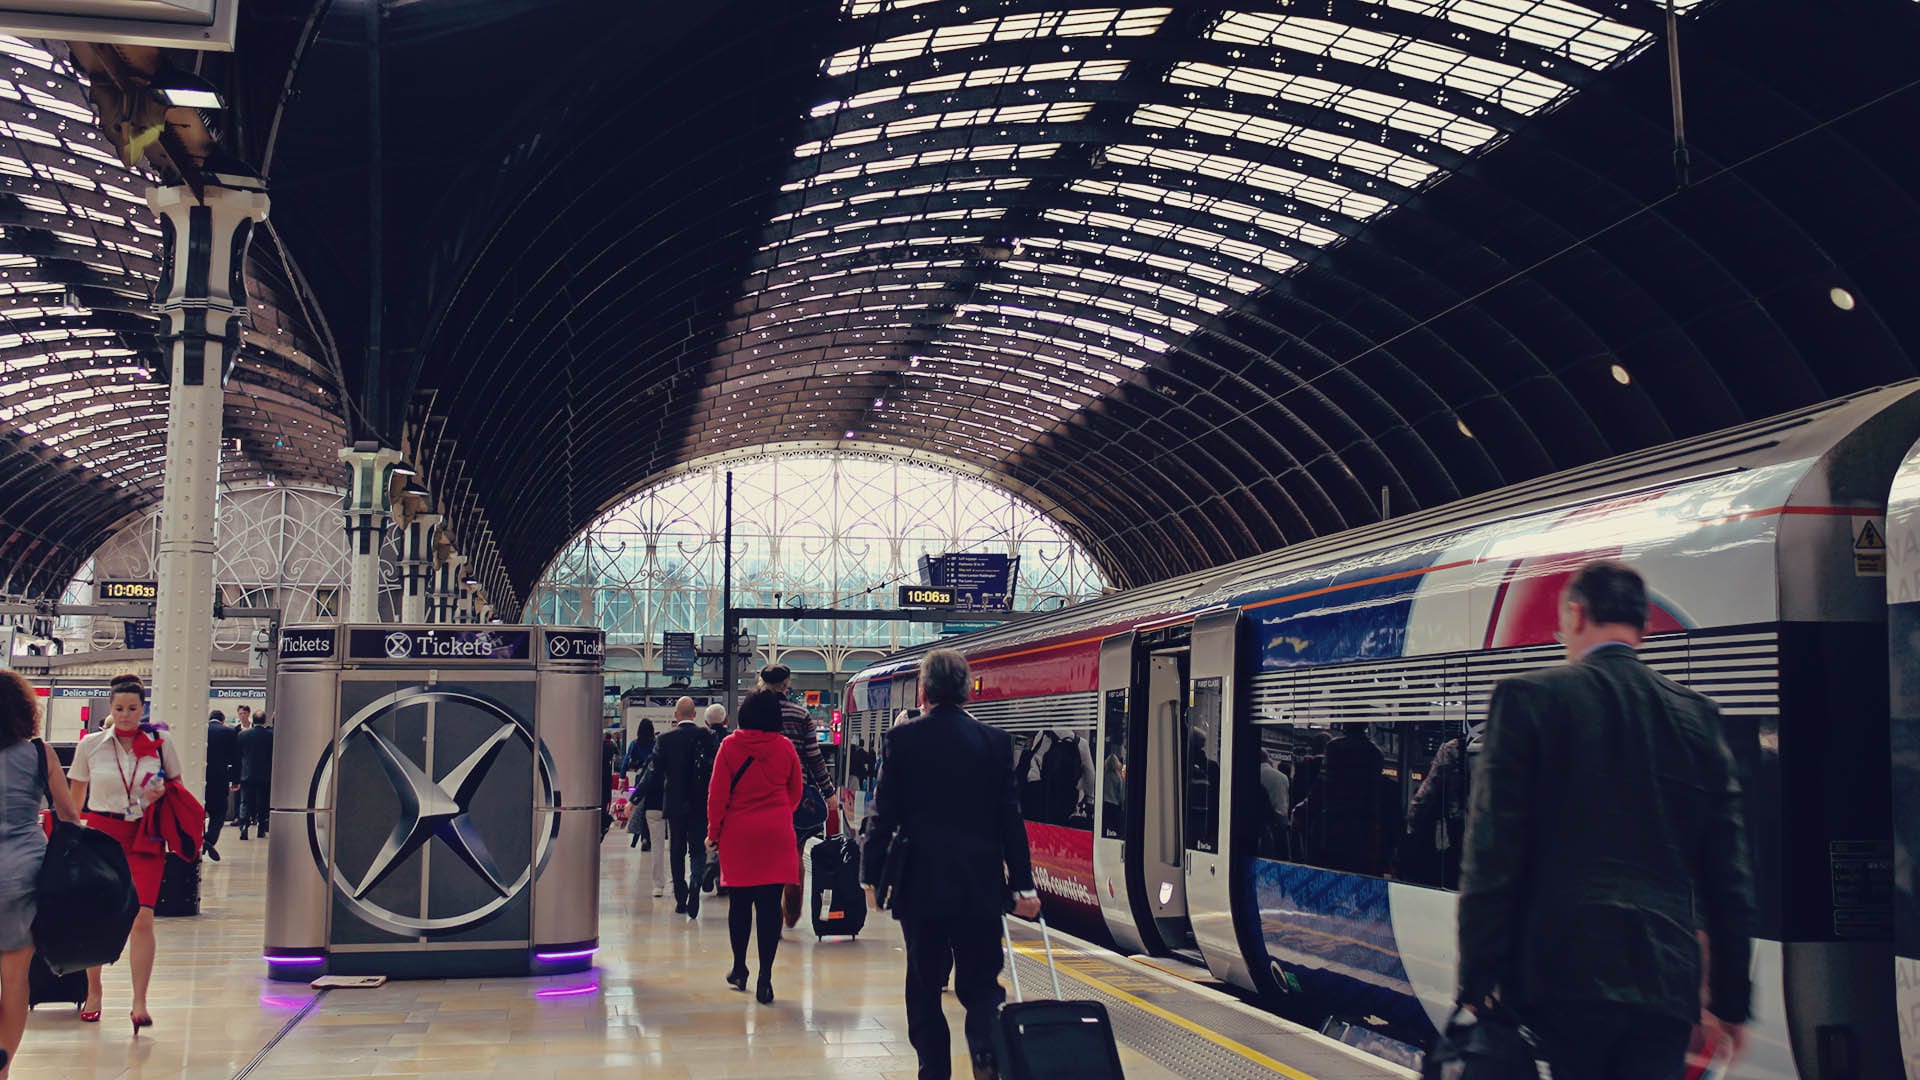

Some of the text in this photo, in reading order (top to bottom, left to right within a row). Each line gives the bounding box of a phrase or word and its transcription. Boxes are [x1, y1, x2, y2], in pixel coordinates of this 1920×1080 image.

[281, 636, 330, 652] Tickets
[417, 636, 493, 656] Tickets
[573, 639, 604, 656] Ticke
[1050, 875, 1091, 905] countries
